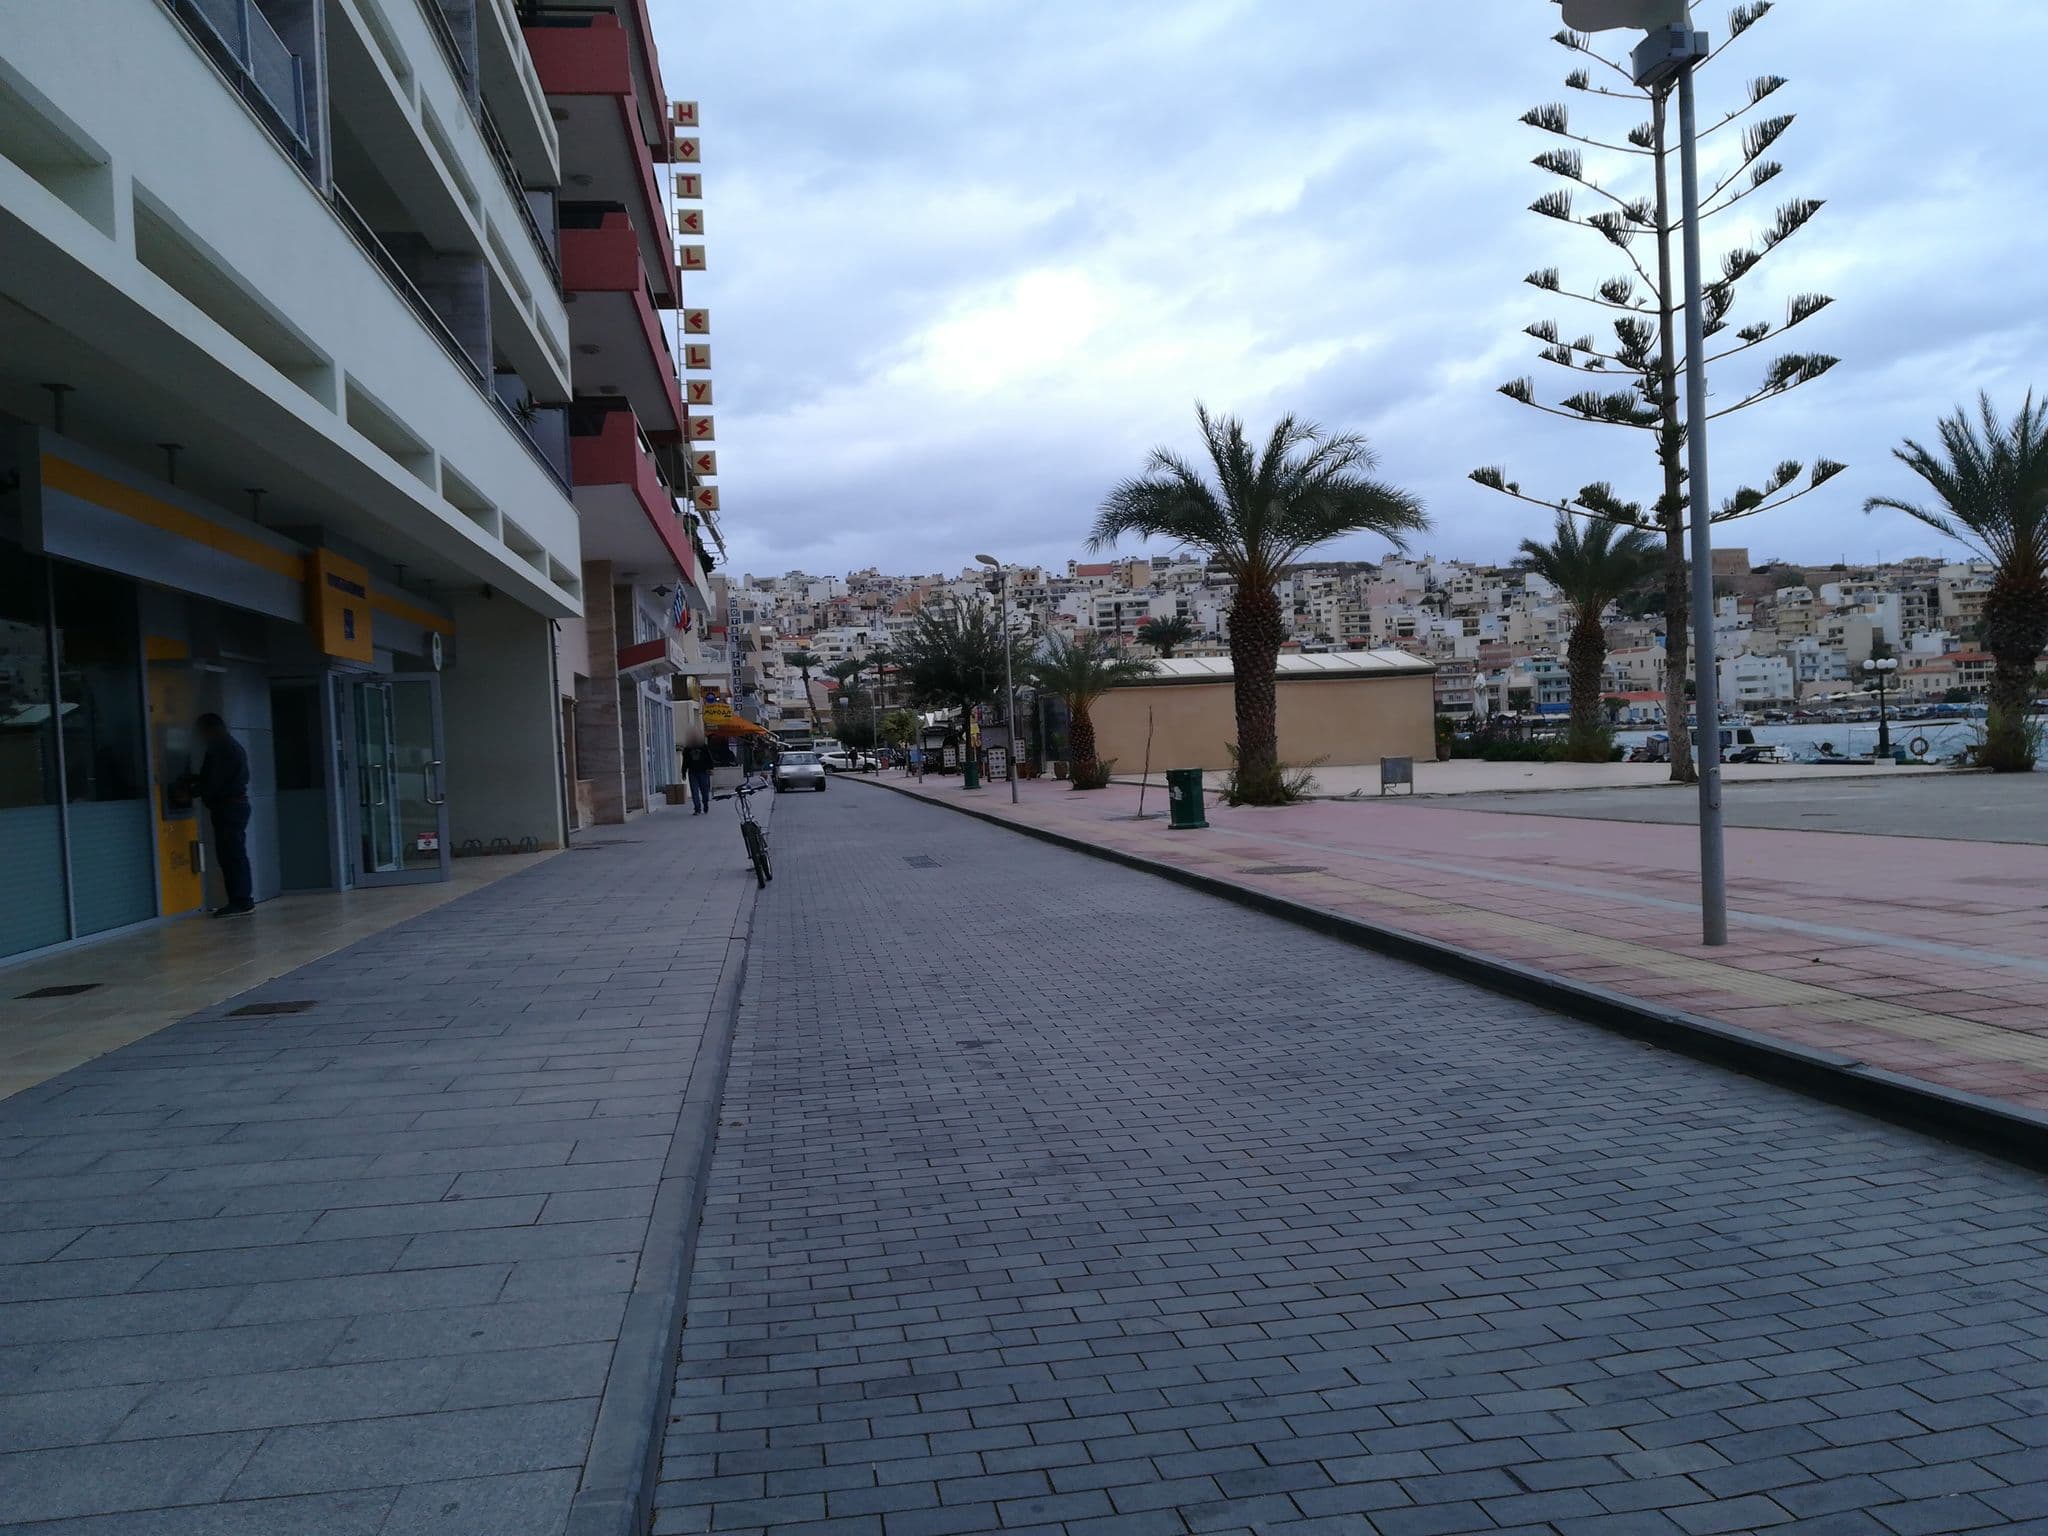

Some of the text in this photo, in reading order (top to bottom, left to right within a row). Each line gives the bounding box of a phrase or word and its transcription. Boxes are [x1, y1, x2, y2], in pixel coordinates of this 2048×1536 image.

[677, 103, 714, 508] HOTEL ELYSEE
[730, 598, 740, 642] HOTEL
